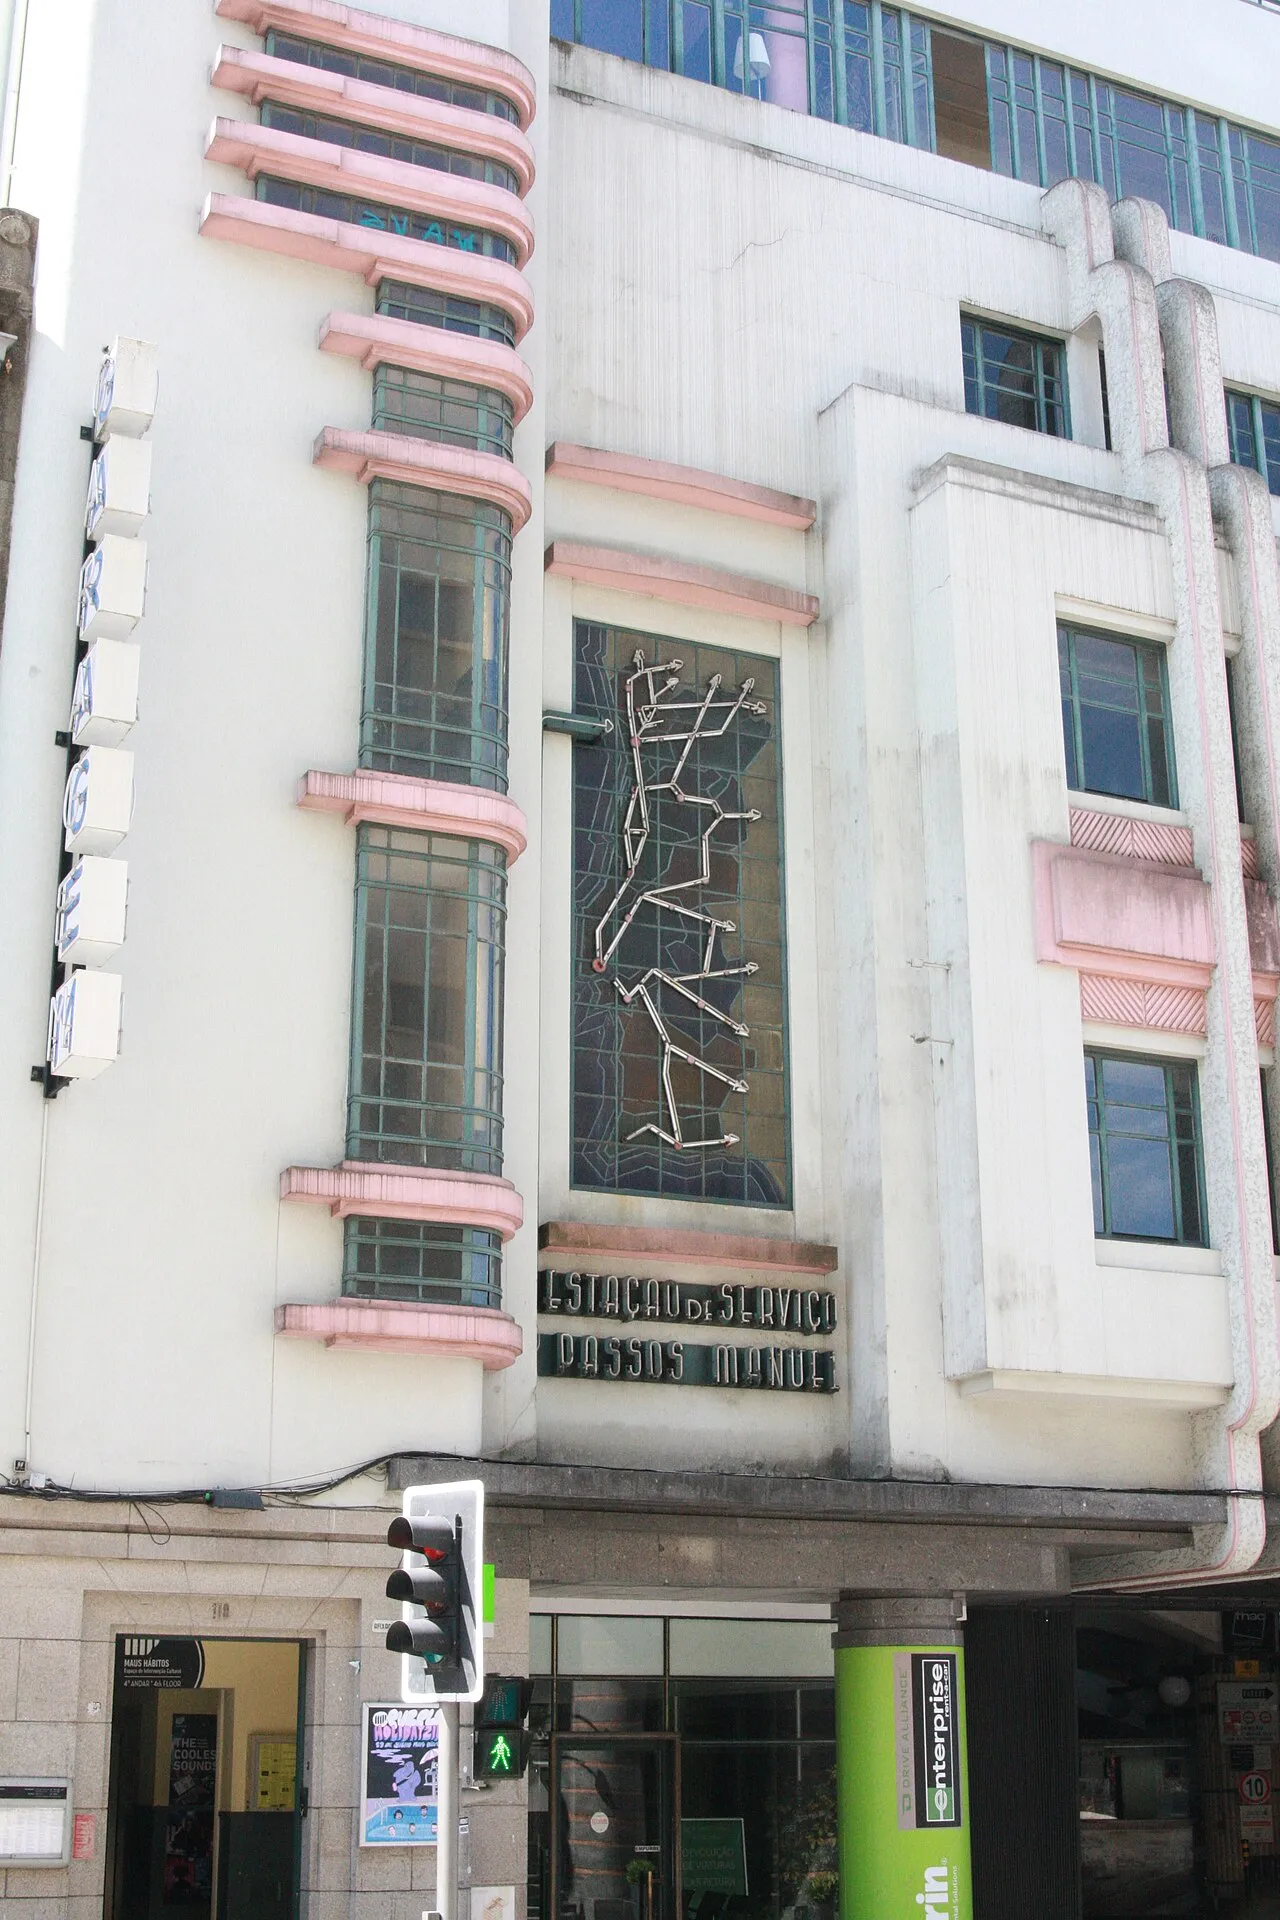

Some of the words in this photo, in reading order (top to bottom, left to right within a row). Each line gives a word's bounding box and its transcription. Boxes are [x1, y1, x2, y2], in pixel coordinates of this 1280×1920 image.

[687, 1298, 713, 1321] DE
[720, 1283, 838, 1332] SERVIÇO
[559, 1333, 684, 1380] PASSOS
[714, 1344, 840, 1390] MANUEL
[1236, 1611, 1266, 1621] fnac
[124, 1659, 142, 1667] MAUS
[143, 1657, 170, 1667] HÁBITOS
[899, 1671, 909, 1742] ALLIANCE
[176, 1737, 197, 1748] THE
[929, 1663, 949, 1814] enterprise
[903, 1746, 911, 1788] DRIVE
[1246, 1778, 1264, 1797] 10
